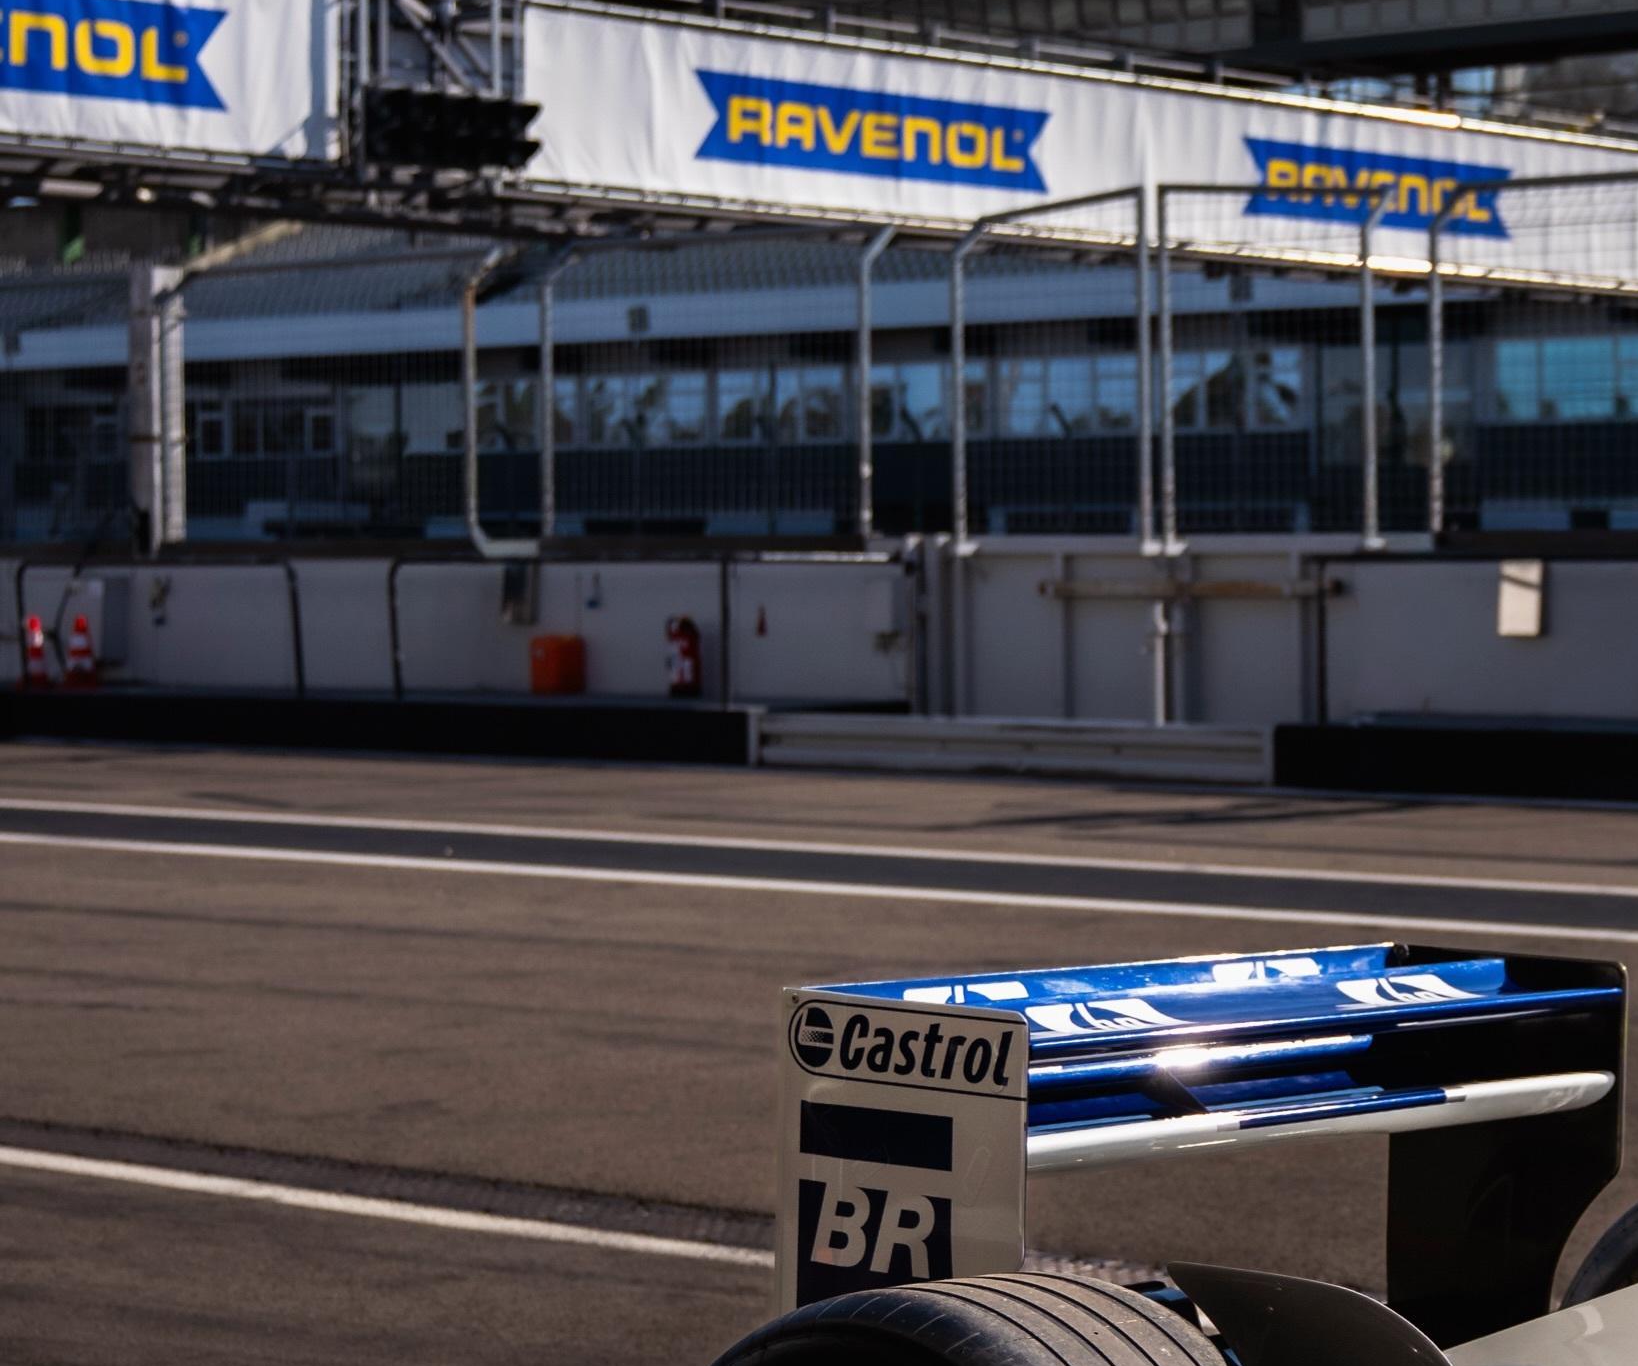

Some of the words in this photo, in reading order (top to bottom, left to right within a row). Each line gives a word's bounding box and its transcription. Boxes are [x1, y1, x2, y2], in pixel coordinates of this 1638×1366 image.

[0, 9, 189, 84] NOL
[727, 95, 1025, 173] RAVENOL
[839, 1014, 1014, 1087] Castrol
[810, 1182, 936, 1280] BR
